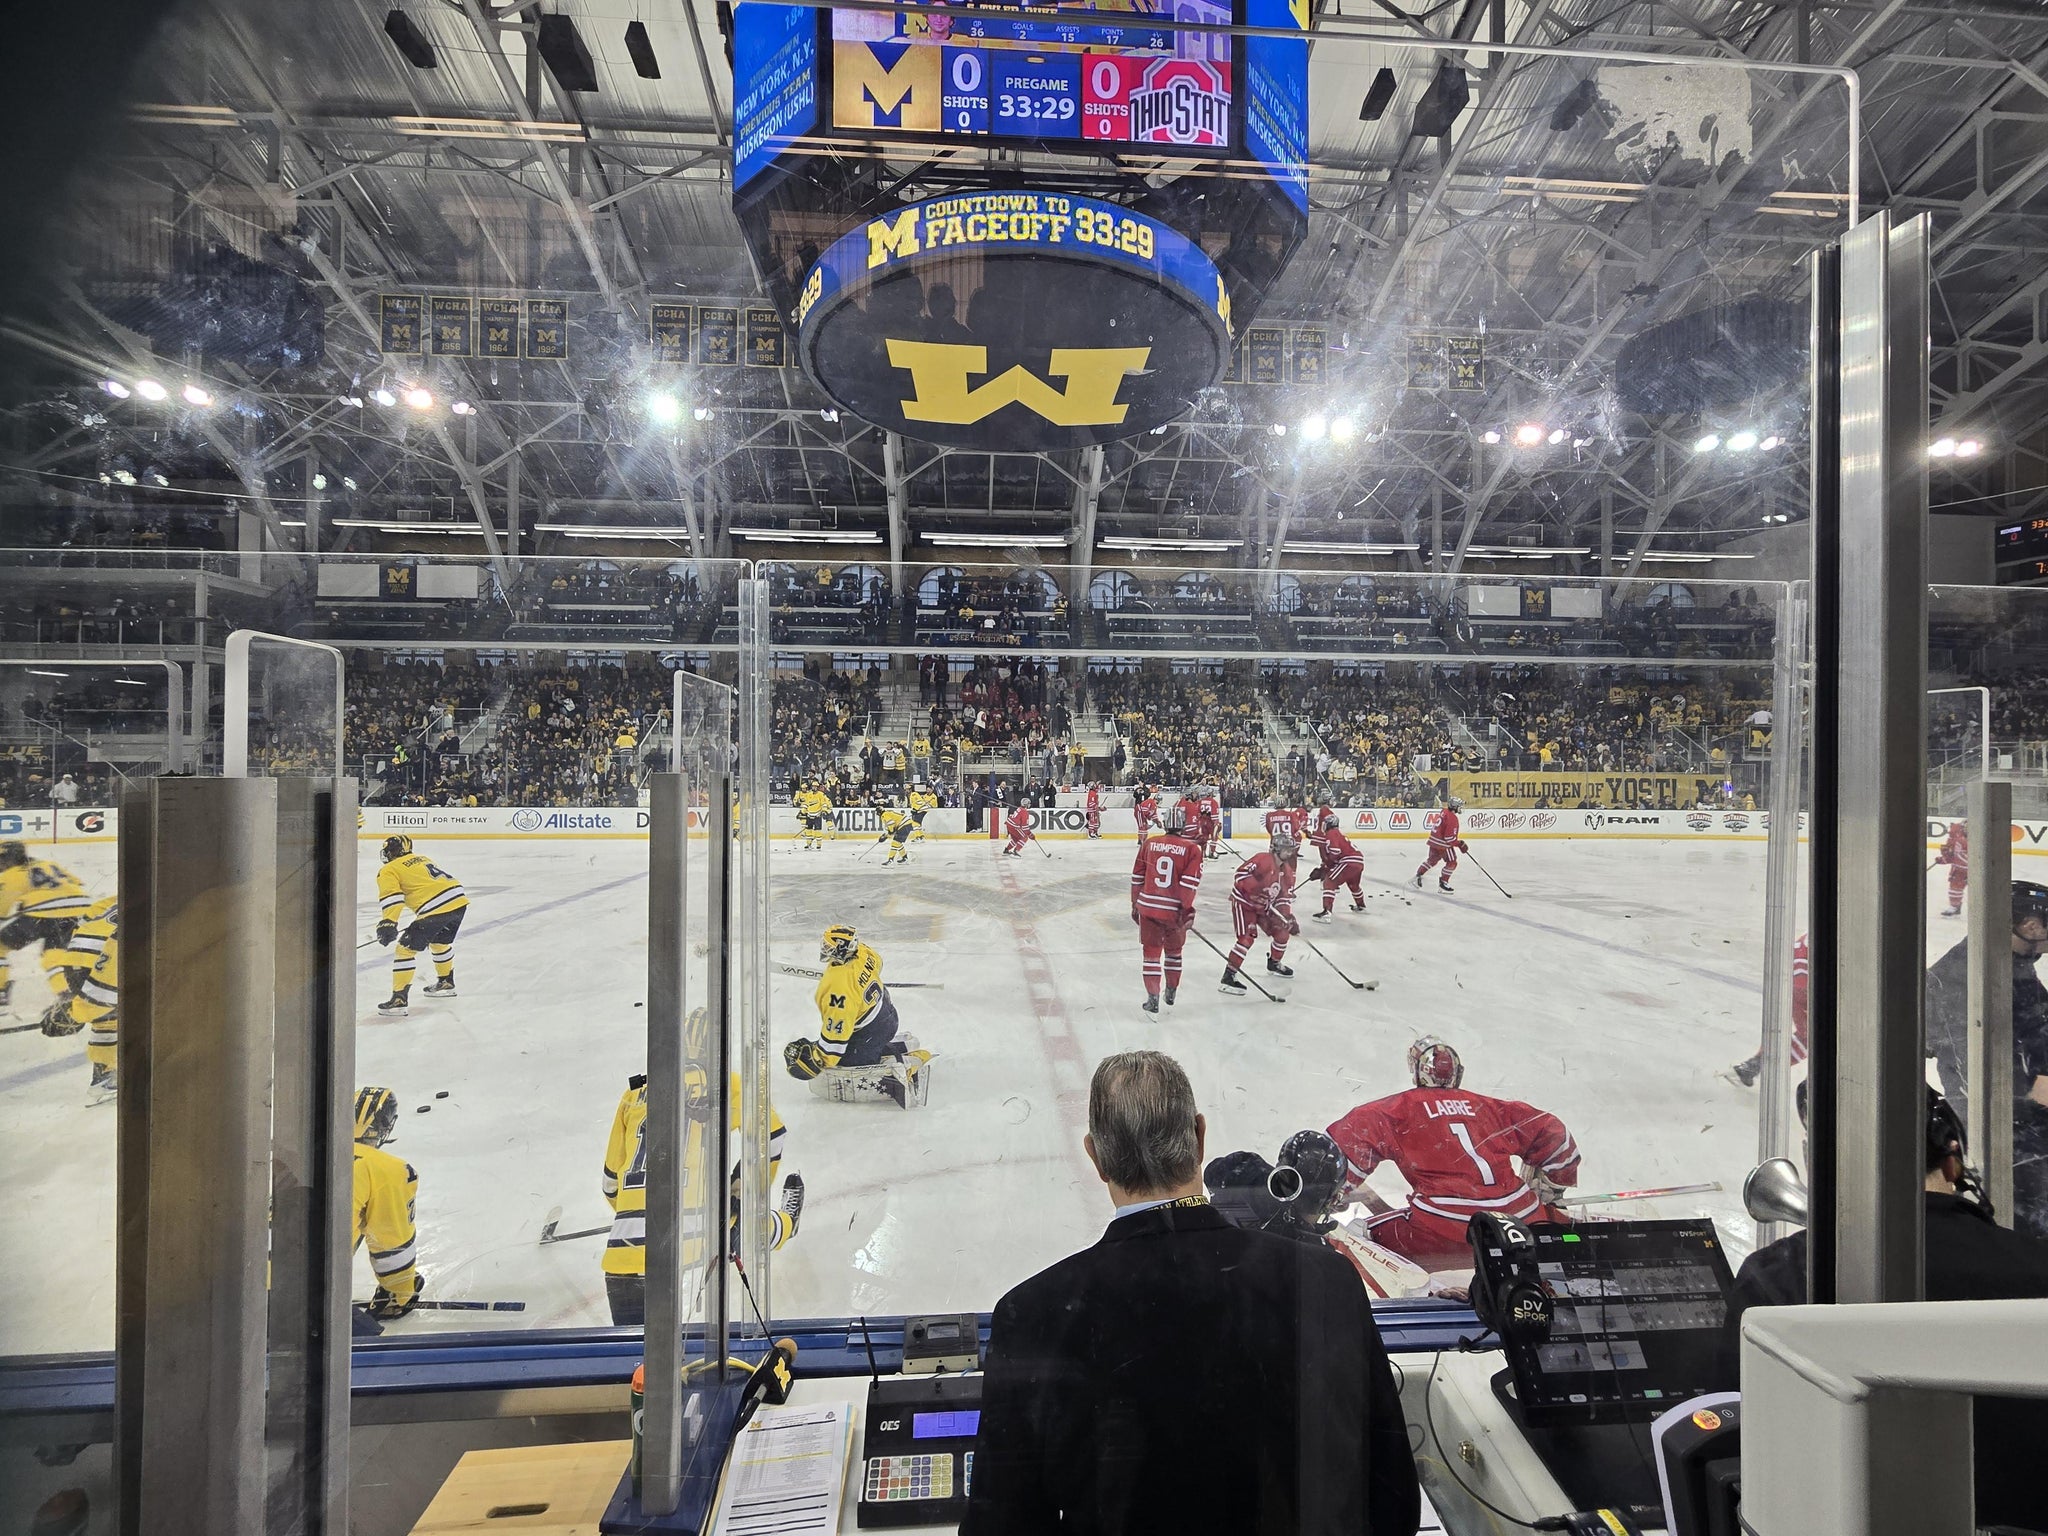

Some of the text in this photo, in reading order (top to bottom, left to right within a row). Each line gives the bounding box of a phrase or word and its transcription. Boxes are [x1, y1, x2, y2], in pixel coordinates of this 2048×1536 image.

[970, 28, 985, 37] 36
[1011, 22, 1034, 31] GOALS
[1055, 25, 1080, 34] ASSISTS
[1101, 28, 1124, 37] POINTS
[1019, 31, 1027, 40] 2
[1061, 33, 1075, 42] 15
[1106, 35, 1120, 45] 17
[1150, 38, 1164, 48] 26
[952, 53, 982, 92] 0
[735, 38, 815, 125] NEW YORK, N.Y.
[1005, 77, 1069, 92] PREGAME
[1091, 61, 1121, 100] 0
[1248, 62, 1268, 99] NEW
[739, 67, 811, 141] PREVIOUS TEAM
[943, 96, 989, 110] SHOTS
[999, 94, 1075, 120] 33:29
[1084, 102, 1129, 116] SHOTS
[735, 82, 814, 166] MUSKEGON (USHL)
[957, 111, 971, 128] 0
[1252, 95, 1285, 145] PREVIOUS
[1099, 119, 1112, 135] 0
[1248, 106, 1287, 168] MUSKEGON
[925, 195, 1070, 219] COUNTDOWN TO
[868, 206, 1155, 270] M FACEOFF 33:29
[434, 302, 469, 311] WCHA
[482, 303, 518, 313] WCHA
[656, 310, 686, 319] CCHA
[704, 311, 733, 321] CCHA
[751, 314, 780, 323] CCHA
[441, 326, 462, 340] M
[488, 327, 509, 341] M
[537, 329, 558, 343] M
[1253, 333, 1279, 341] CCHA
[1295, 335, 1322, 343] CCHA
[537, 346, 557, 354] 1992
[756, 338, 776, 351] M
[756, 353, 775, 362] 1996
[1258, 356, 1275, 369] M
[1300, 357, 1318, 370] M
[1458, 365, 1475, 378] M
[1459, 380, 1474, 388] 2011
[387, 567, 409, 583] M
[1526, 590, 1545, 604] M
[1470, 782, 1502, 798] THE
[1506, 782, 1582, 798] CHILDREN
[1587, 782, 1604, 798] OF
[1605, 777, 1677, 804] YOST!
[387, 815, 425, 825] Hilton
[545, 813, 612, 829] Allstate
[1469, 816, 1494, 829] Pepper
[1499, 816, 1525, 829] Pepper
[1530, 816, 1556, 829] Pepper
[1607, 816, 1660, 825] RAM
[1150, 842, 1186, 856] THOMPSON
[1154, 856, 1174, 888] 9
[829, 994, 846, 1009] M
[825, 1017, 844, 1034] 34
[1423, 1099, 1476, 1119] LABRE
[1448, 1123, 1496, 1186] 1
[1348, 1236, 1401, 1274] TRUE
[1523, 1300, 1543, 1311] DV
[880, 1420, 900, 1431] OES
